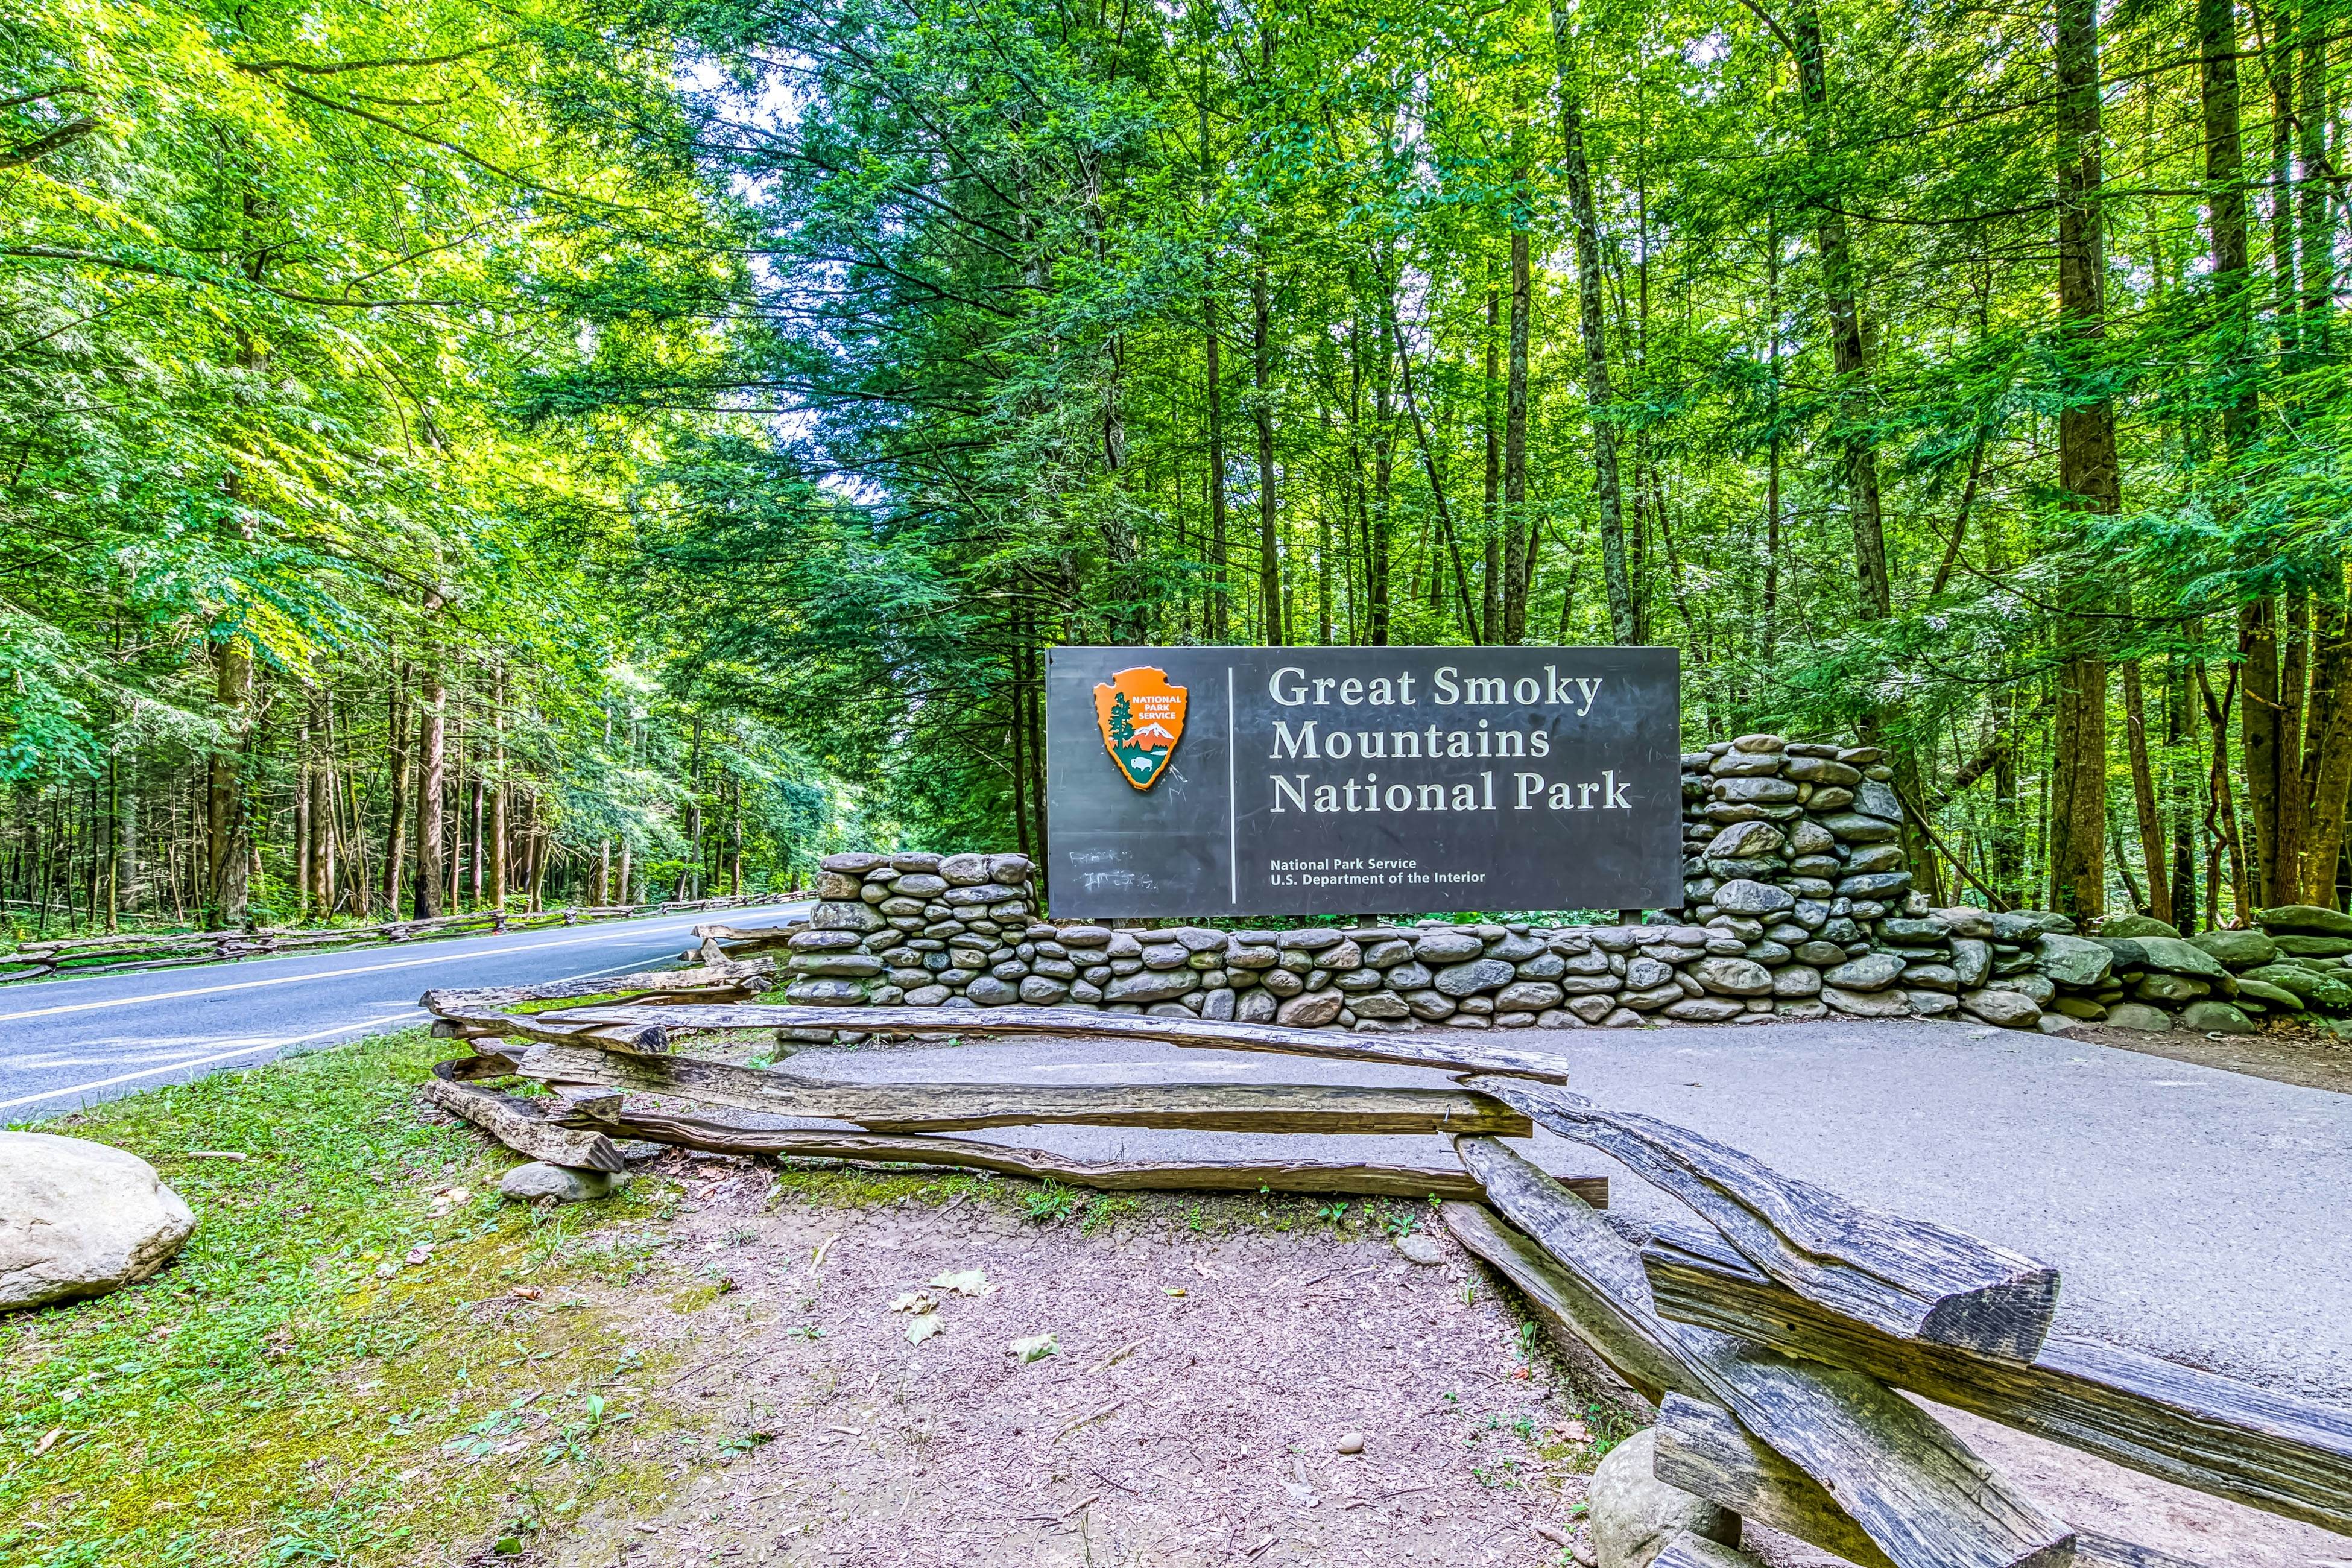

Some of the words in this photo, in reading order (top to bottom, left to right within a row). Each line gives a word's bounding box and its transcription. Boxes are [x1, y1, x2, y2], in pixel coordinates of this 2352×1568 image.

[1269, 666, 1416, 706] Great
[1434, 665, 1602, 716] Smoky
[1269, 719, 1550, 759] Mountains
[1269, 771, 1496, 812] National
[1514, 770, 1632, 810] Park
[1271, 859, 1329, 870] National
[1334, 858, 1364, 870] Park
[1368, 858, 1417, 869] Service
[1271, 874, 1297, 885] U.S.
[1303, 873, 1384, 887] Department
[1389, 872, 1403, 884] of
[1408, 873, 1429, 884] the
[1435, 871, 1485, 883] Interior
